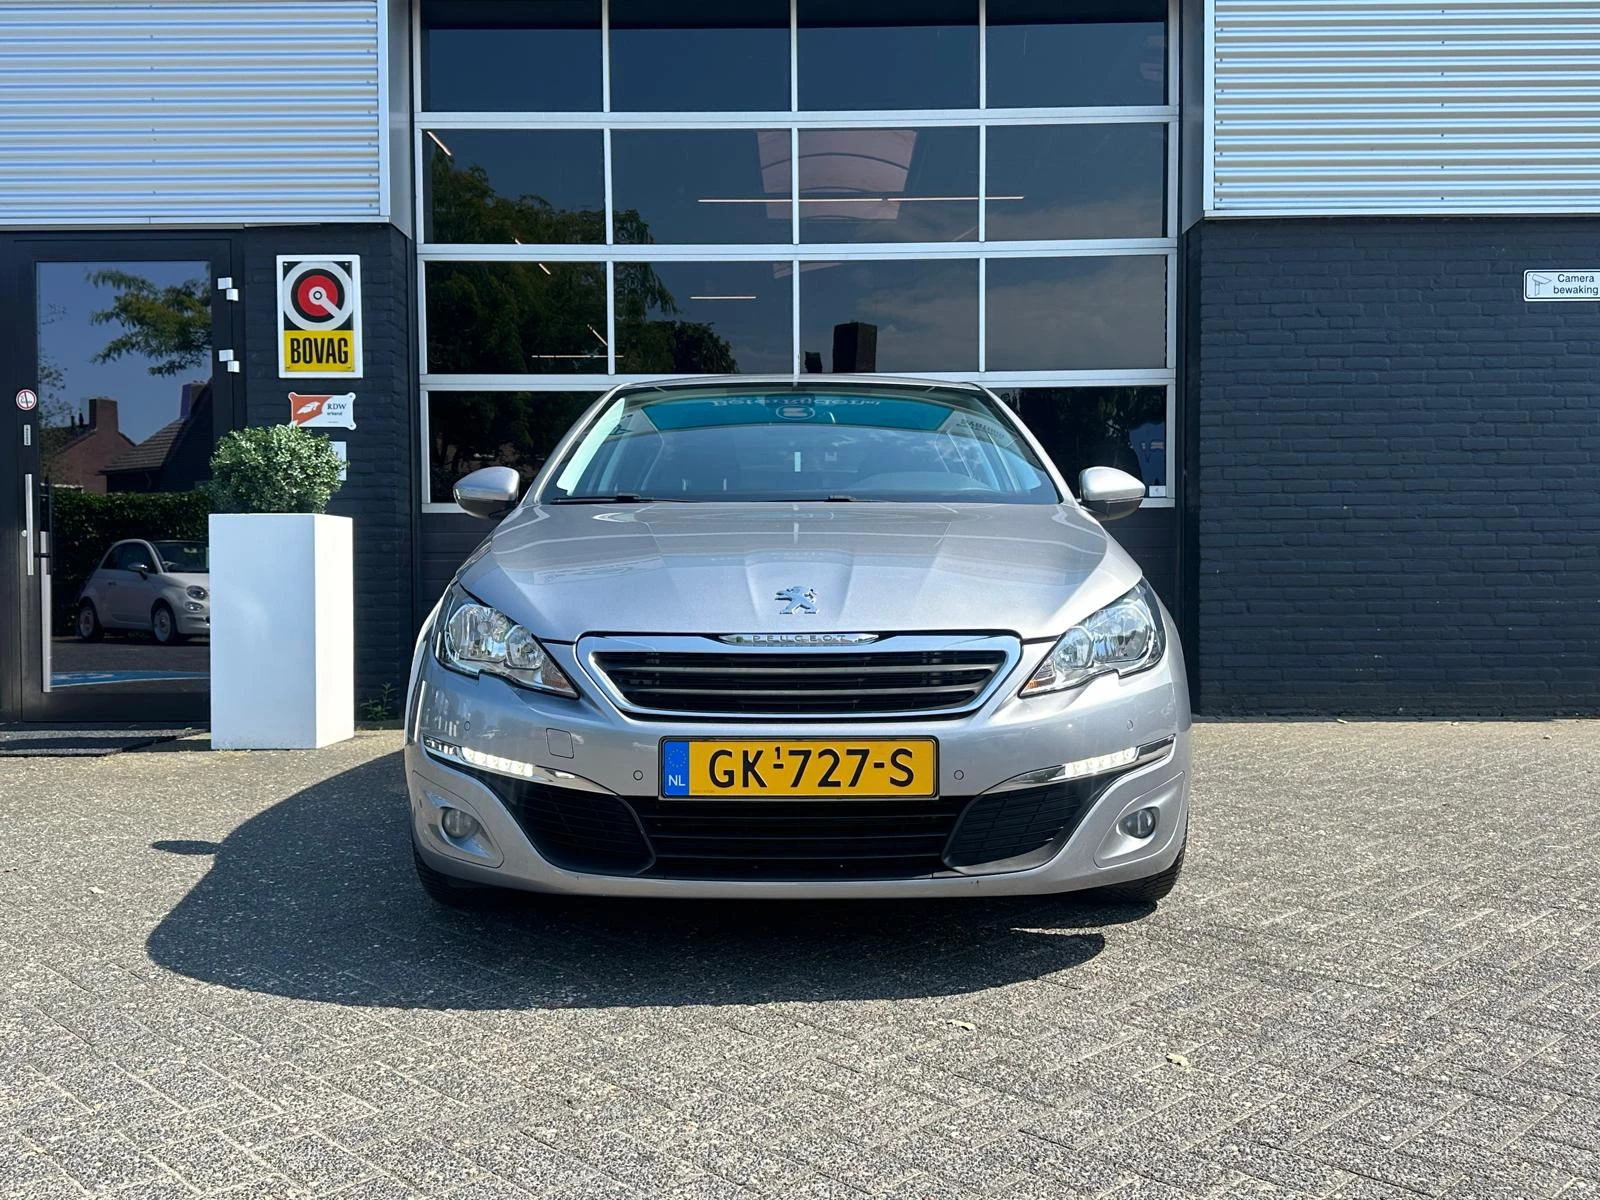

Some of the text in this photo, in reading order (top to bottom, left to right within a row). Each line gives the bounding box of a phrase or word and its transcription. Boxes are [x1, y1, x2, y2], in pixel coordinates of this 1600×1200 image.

[1557, 273, 1595, 283] Camera
[1553, 285, 1599, 296] bewaking
[290, 337, 348, 364] BOVAG
[752, 634, 846, 643] PEUGEOT
[668, 774, 686, 787] NL
